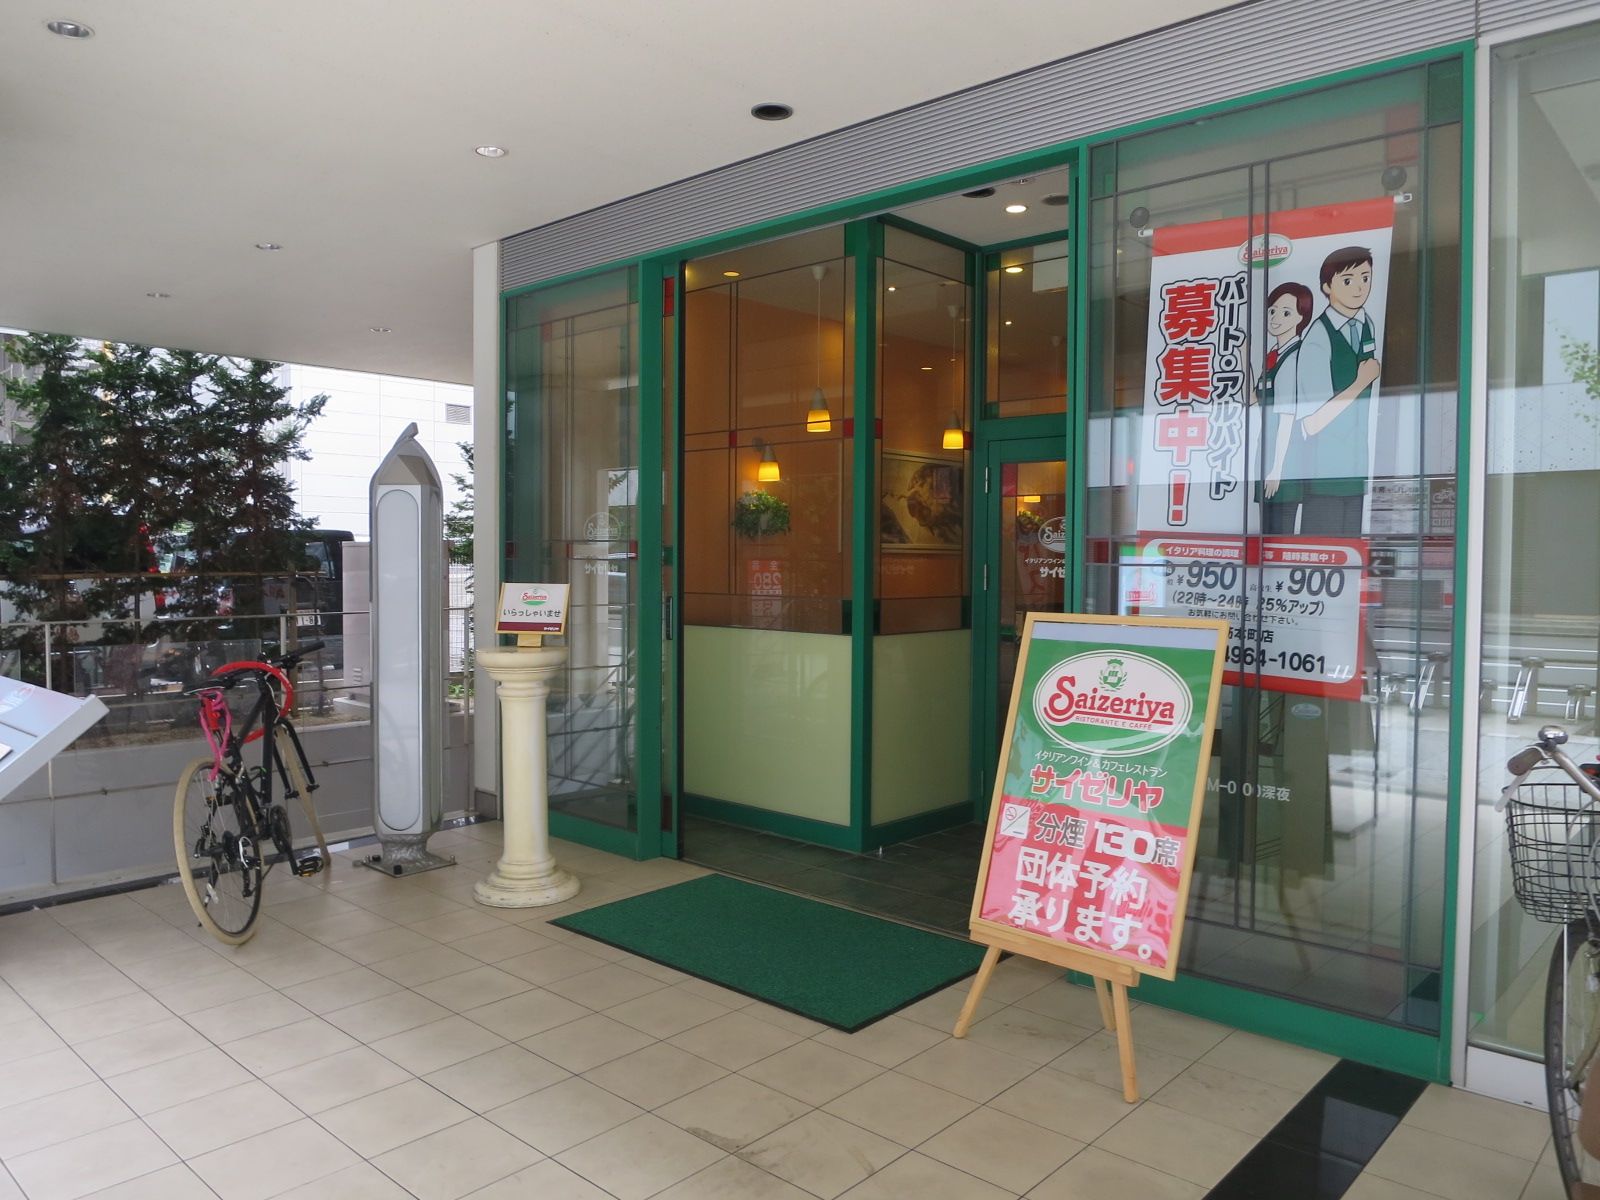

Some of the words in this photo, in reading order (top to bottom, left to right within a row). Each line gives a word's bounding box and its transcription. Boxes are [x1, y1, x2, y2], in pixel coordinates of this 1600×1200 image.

[503, 608, 561, 617] いらっしゃいませ
[1046, 675, 1175, 721] Saizeriya
[1074, 714, 1119, 727] RISTORANTE
[1031, 764, 1164, 812] サイゼリヤ
[1034, 812, 1088, 850] 分煙
[1016, 847, 1148, 907] 団体予約
[1008, 888, 1151, 959] 承ります。
